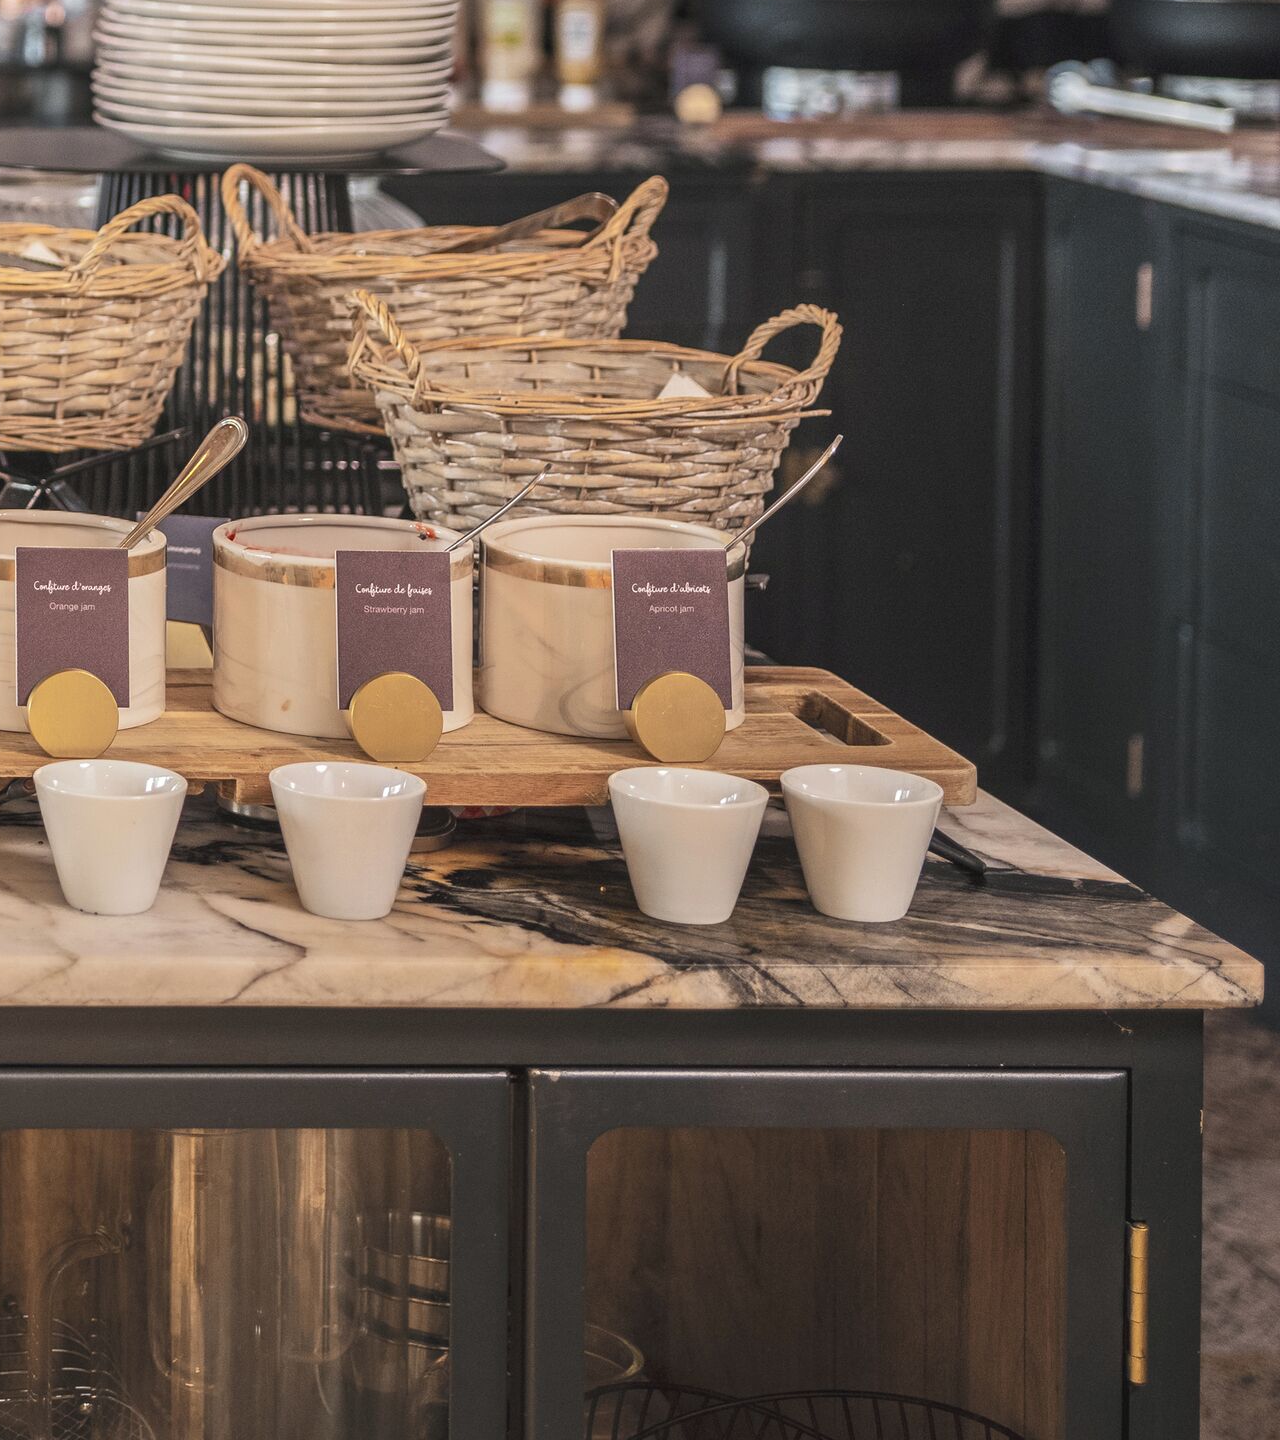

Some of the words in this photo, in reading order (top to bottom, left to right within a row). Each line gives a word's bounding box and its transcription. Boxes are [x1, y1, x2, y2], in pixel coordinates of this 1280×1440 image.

[33, 580, 70, 594] Confiture
[71, 581, 112, 595] d'oranges
[355, 582, 392, 597] Confiture
[394, 583, 406, 594] de
[407, 583, 433, 598] fraises
[631, 582, 668, 597] Confiture
[669, 582, 711, 594] d'abricots
[49, 602, 79, 612] Orange
[80, 603, 96, 612] jam
[363, 605, 408, 615] Strawberry
[409, 606, 425, 615] jam
[648, 605, 678, 614] Apricot
[679, 605, 695, 614] jam
